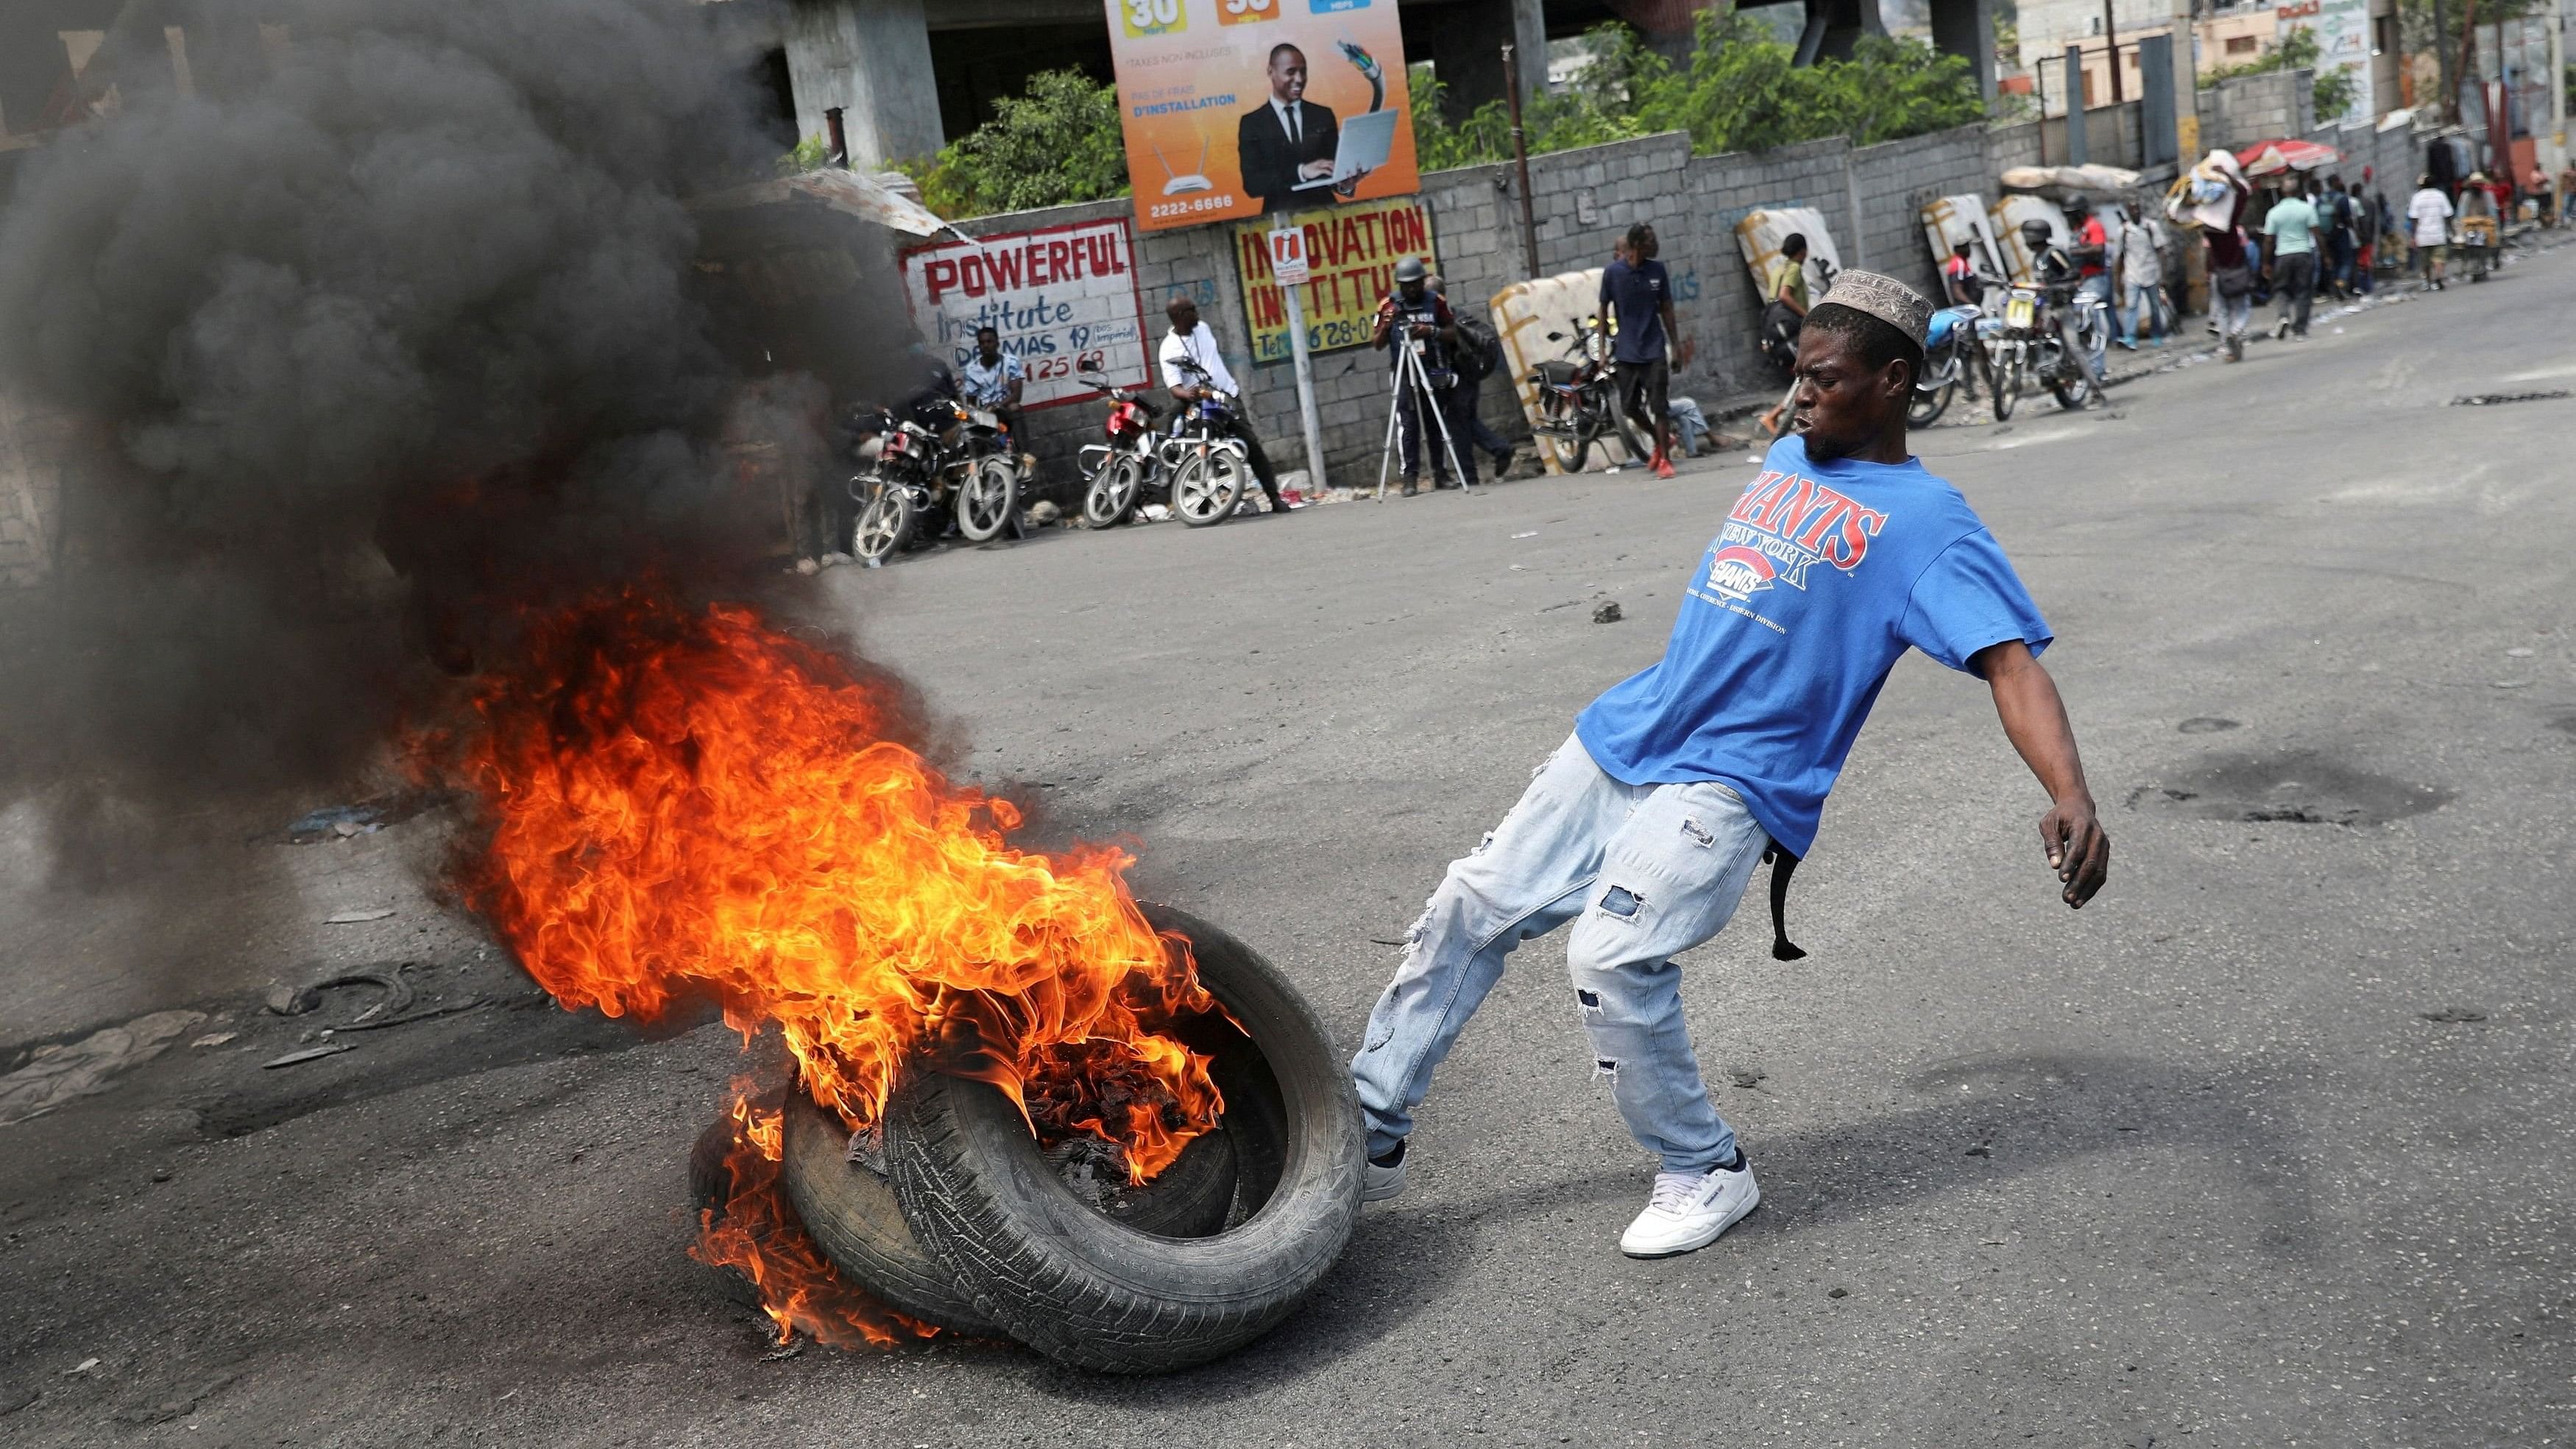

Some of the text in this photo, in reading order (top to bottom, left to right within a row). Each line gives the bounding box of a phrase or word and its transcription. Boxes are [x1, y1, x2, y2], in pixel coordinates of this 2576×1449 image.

[1133, 93, 1236, 118] D'INSTALLATION
[1150, 194, 1234, 218] 2222-6666
[1242, 205, 1429, 281] INOVATION
[924, 232, 1126, 306] POWERFUL
[936, 295, 1075, 344] Institute
[1070, 326, 1089, 350] 19
[1728, 470, 1889, 572] IANTS
[1709, 560, 1763, 595] GIANTS
[1755, 532, 1820, 592] YORK
[1755, 614, 1787, 635] DIVISION
